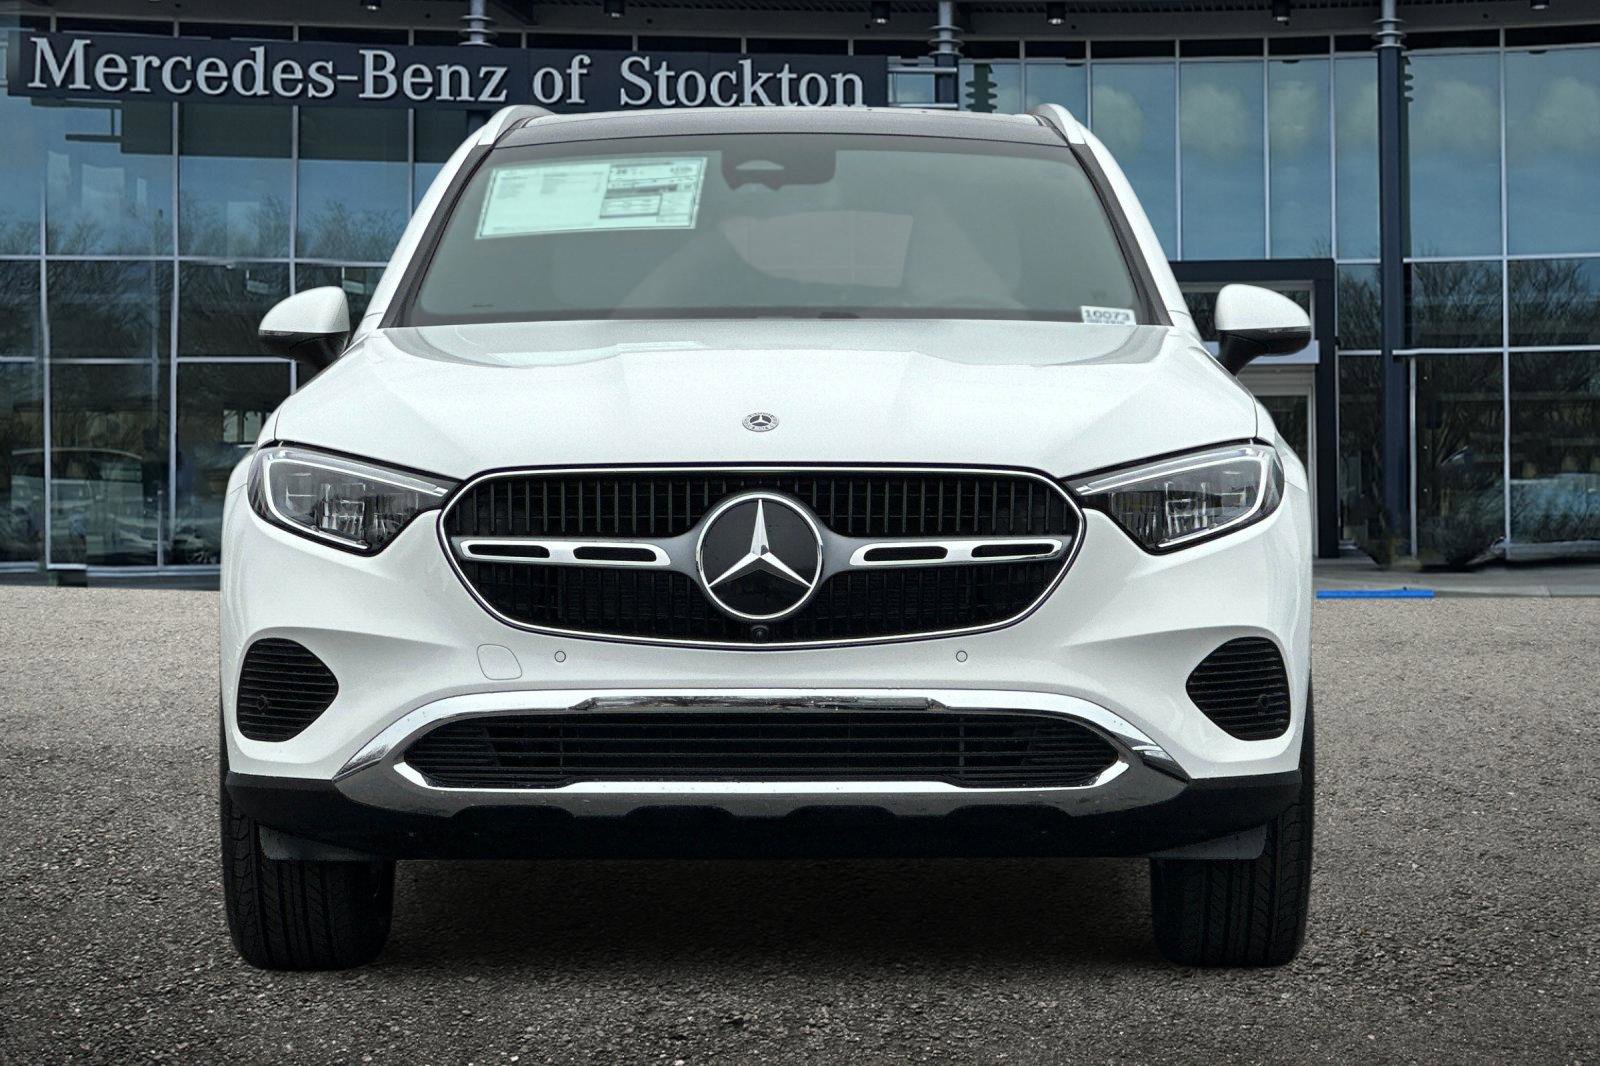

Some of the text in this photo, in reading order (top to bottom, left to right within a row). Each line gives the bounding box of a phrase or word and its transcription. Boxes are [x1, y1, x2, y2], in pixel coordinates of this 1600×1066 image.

[27, 37, 868, 107] Mercedes-Benz of Stockton
